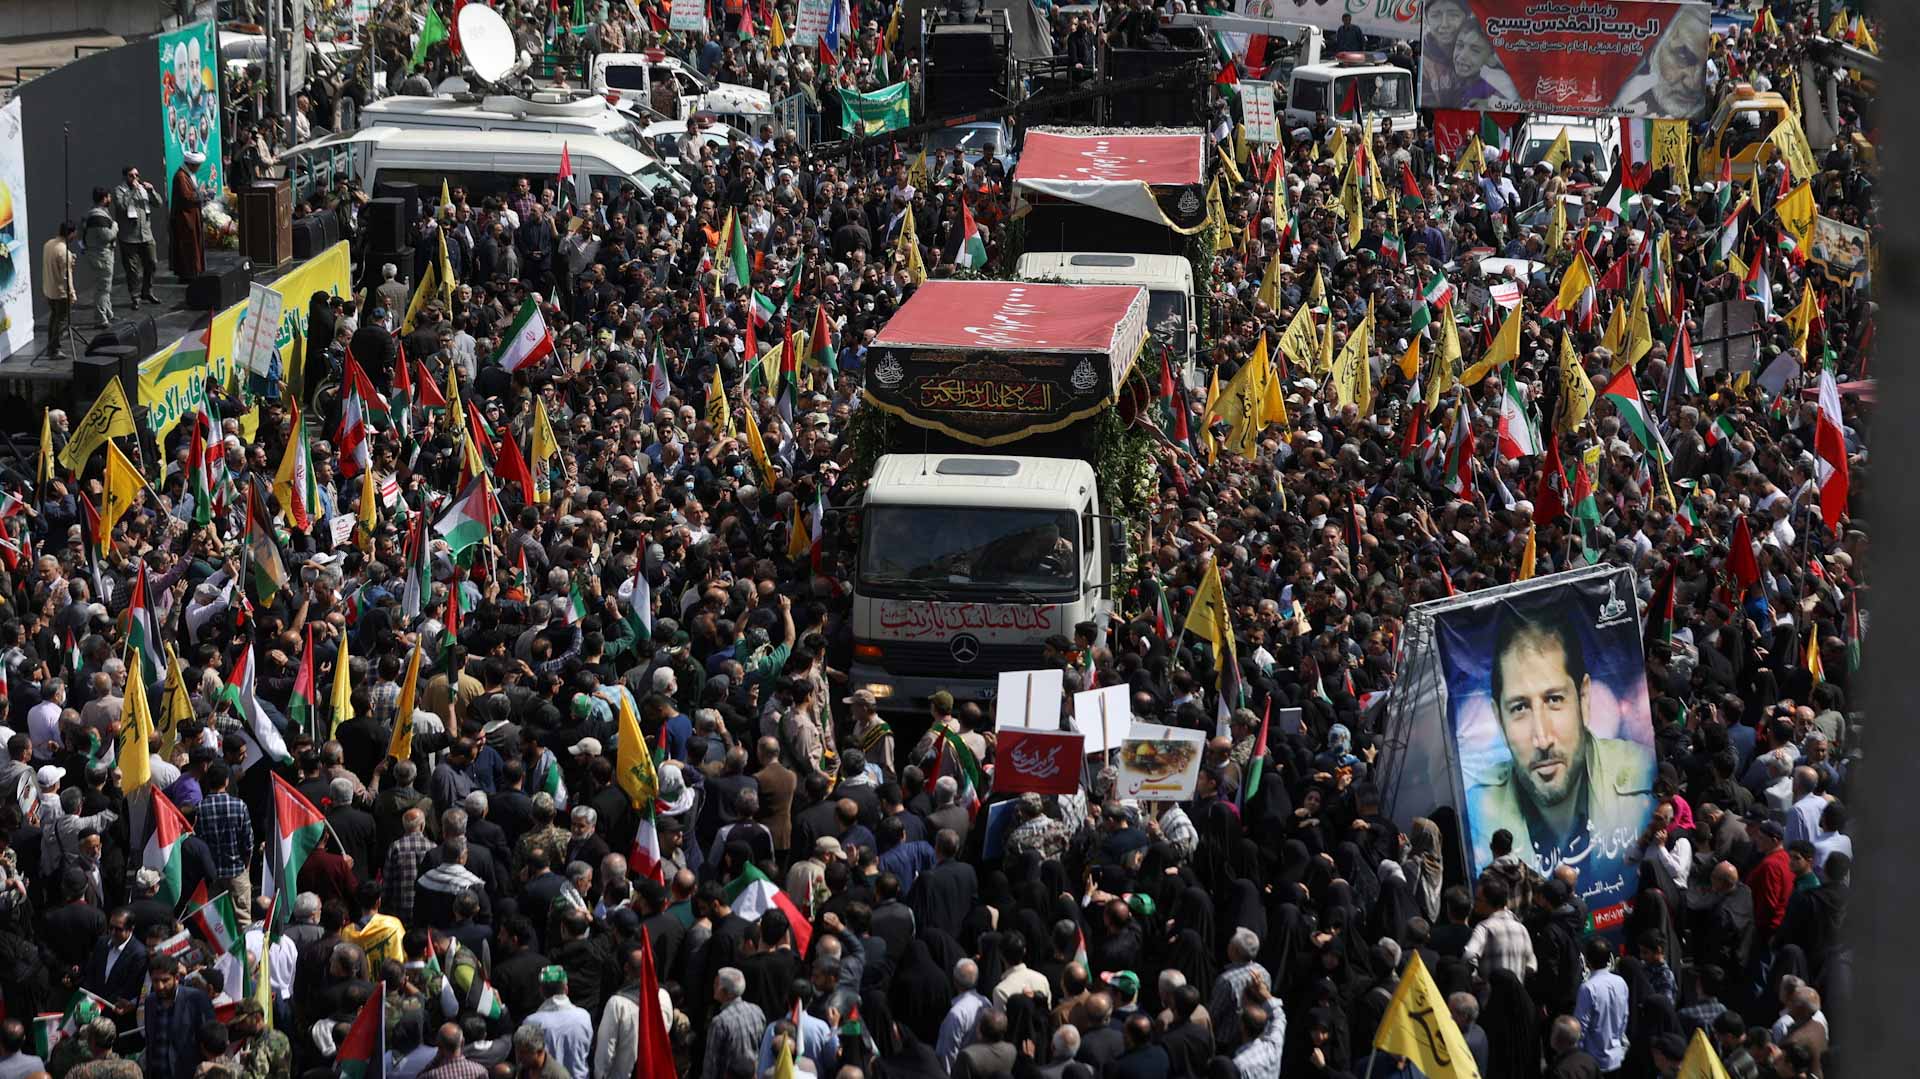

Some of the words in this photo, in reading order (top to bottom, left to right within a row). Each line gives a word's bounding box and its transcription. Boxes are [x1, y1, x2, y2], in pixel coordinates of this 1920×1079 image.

[1526, 3, 1570, 16] حماسی
[1570, 2, 1617, 19] رزمایش
[1486, 16, 1531, 37] بسیج
[1532, 15, 1601, 36] المقدس
[1601, 18, 1634, 38] بیت
[1633, 18, 1660, 40] الی
